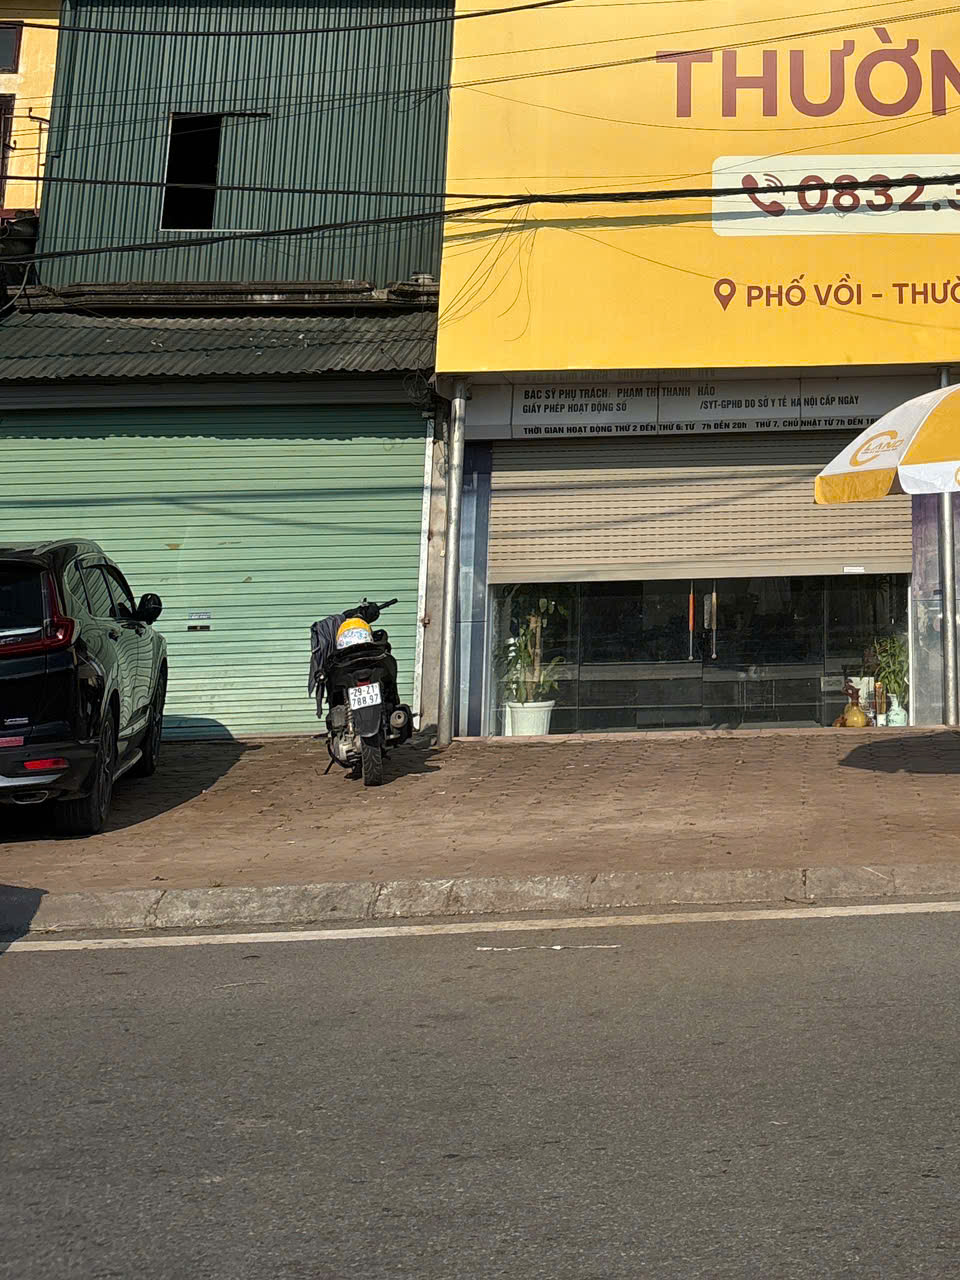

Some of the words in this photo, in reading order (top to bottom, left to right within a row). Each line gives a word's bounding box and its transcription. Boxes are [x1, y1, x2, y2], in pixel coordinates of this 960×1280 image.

[746, 274, 806, 307] PHỐ
[813, 273, 862, 306] VỒI
[523, 400, 541, 414] GIẤY
[544, 401, 565, 413] PHÉP
[567, 403, 589, 414] HOẠT
[591, 402, 614, 414] ĐỘNG
[744, 399, 755, 408] DO
[770, 398, 776, 407] Y
[778, 395, 787, 407] TẾ
[804, 395, 818, 408] NỘI
[820, 393, 836, 406] CẤP
[838, 393, 859, 405] NGÀY
[524, 386, 542, 400] BÁC
[558, 388, 576, 401] PHỤ
[617, 387, 643, 400] PHẠM
[662, 386, 690, 397] THANH
[524, 424, 542, 434] THỜI
[544, 426, 565, 434] GIAN
[566, 425, 587, 435] HOẠT
[590, 425, 613, 434] ĐỘNG
[615, 424, 631, 432] THỨ
[639, 422, 656, 432] ĐẾN
[659, 421, 675, 431] THỨ
[714, 419, 730, 429] ĐẾN
[732, 421, 747, 429] 20h
[755, 419, 771, 429] THỨ
[782, 417, 799, 427] CHỦ
[801, 418, 822, 428] NHẬT
[836, 418, 846, 426] 7h
[847, 416, 863, 426] ĐẾN
